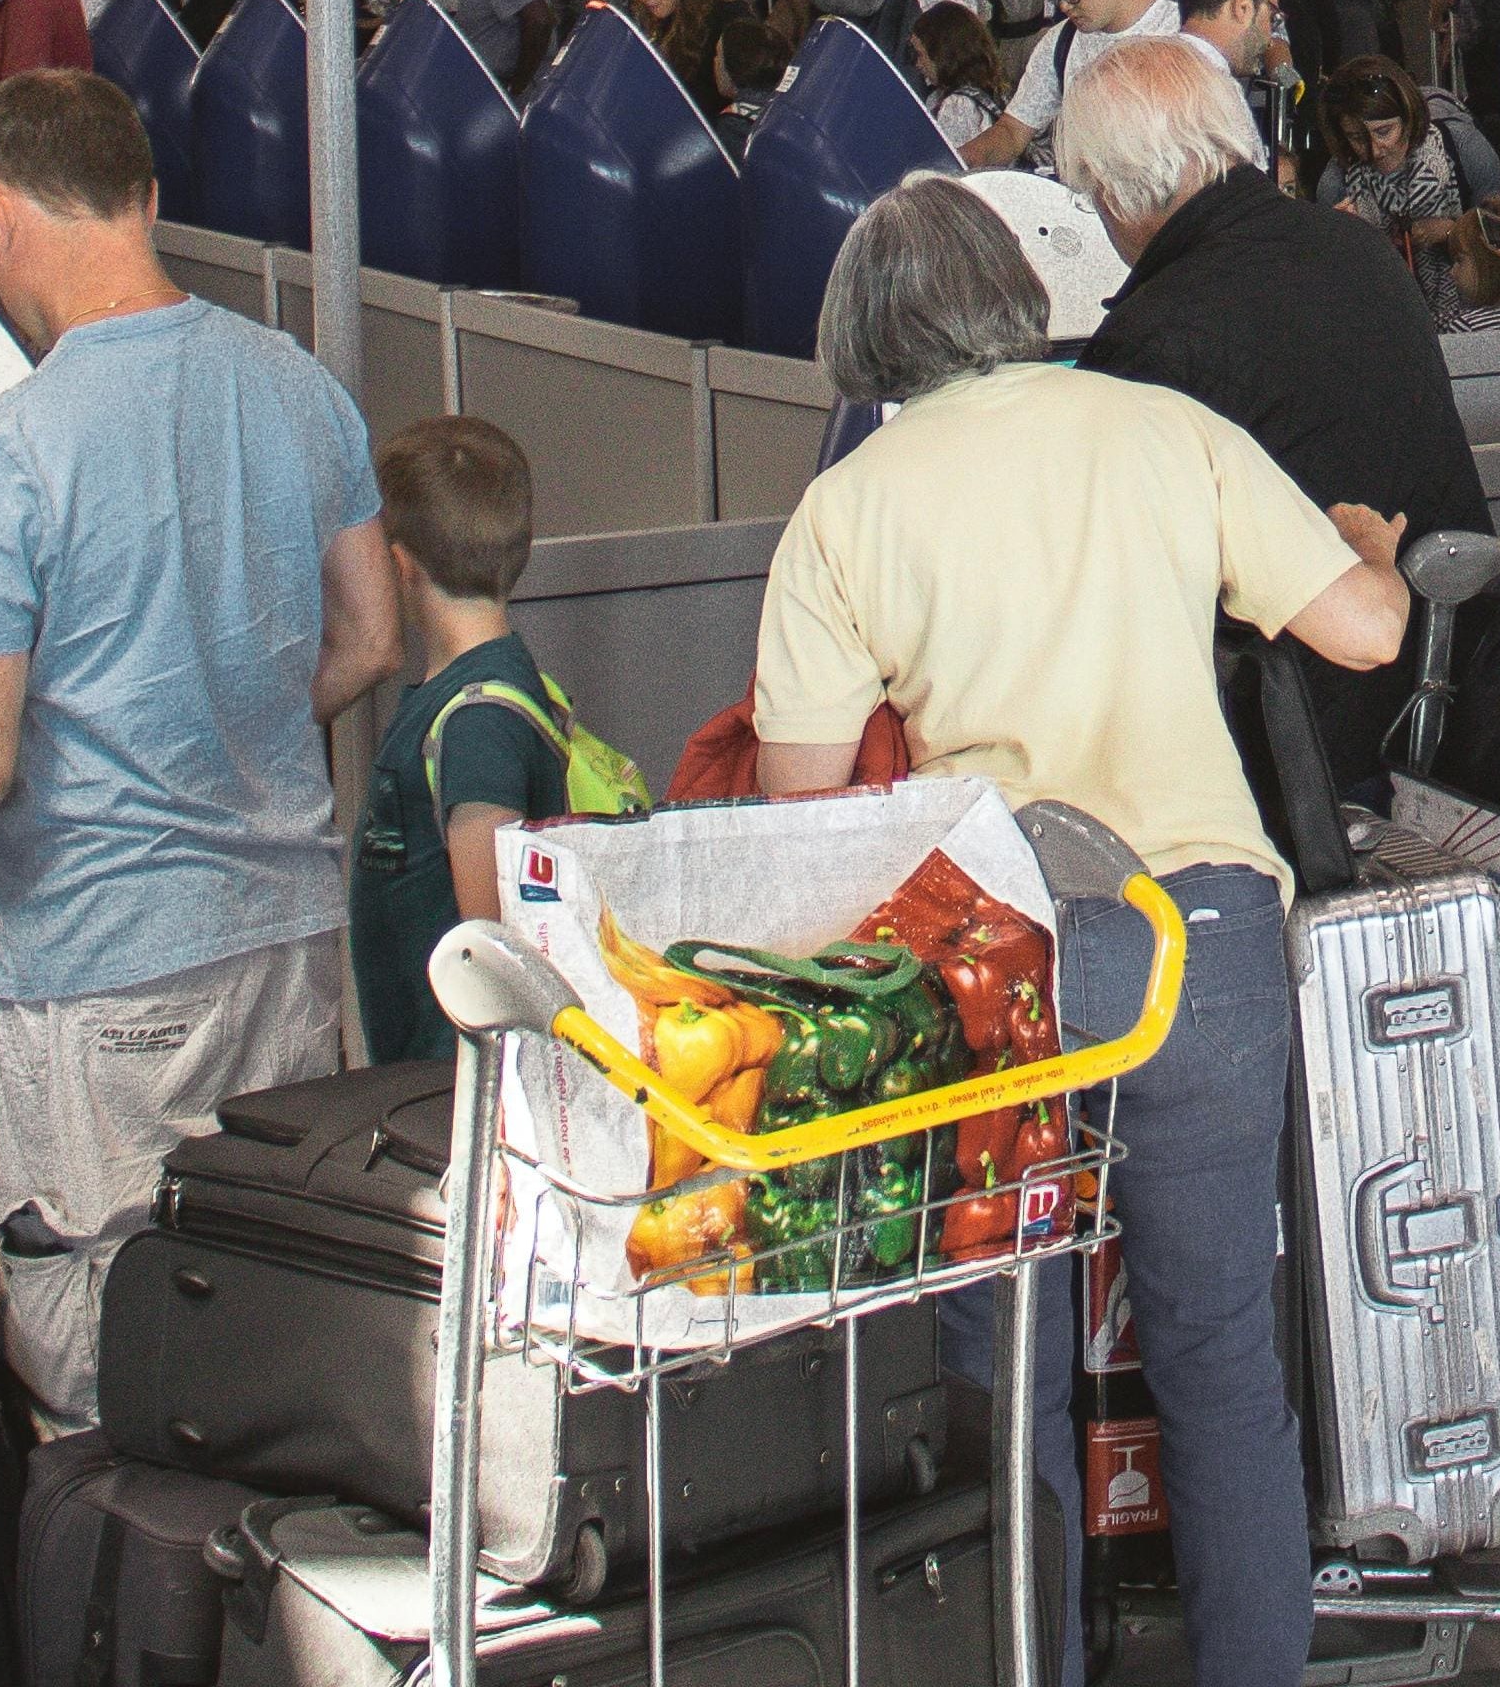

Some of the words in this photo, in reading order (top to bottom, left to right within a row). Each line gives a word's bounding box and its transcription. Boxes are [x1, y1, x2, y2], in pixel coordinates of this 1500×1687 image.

[948, 1091, 979, 1108] please
[557, 1105, 570, 1144] notre
[1097, 1508, 1159, 1527] FRAGILE
